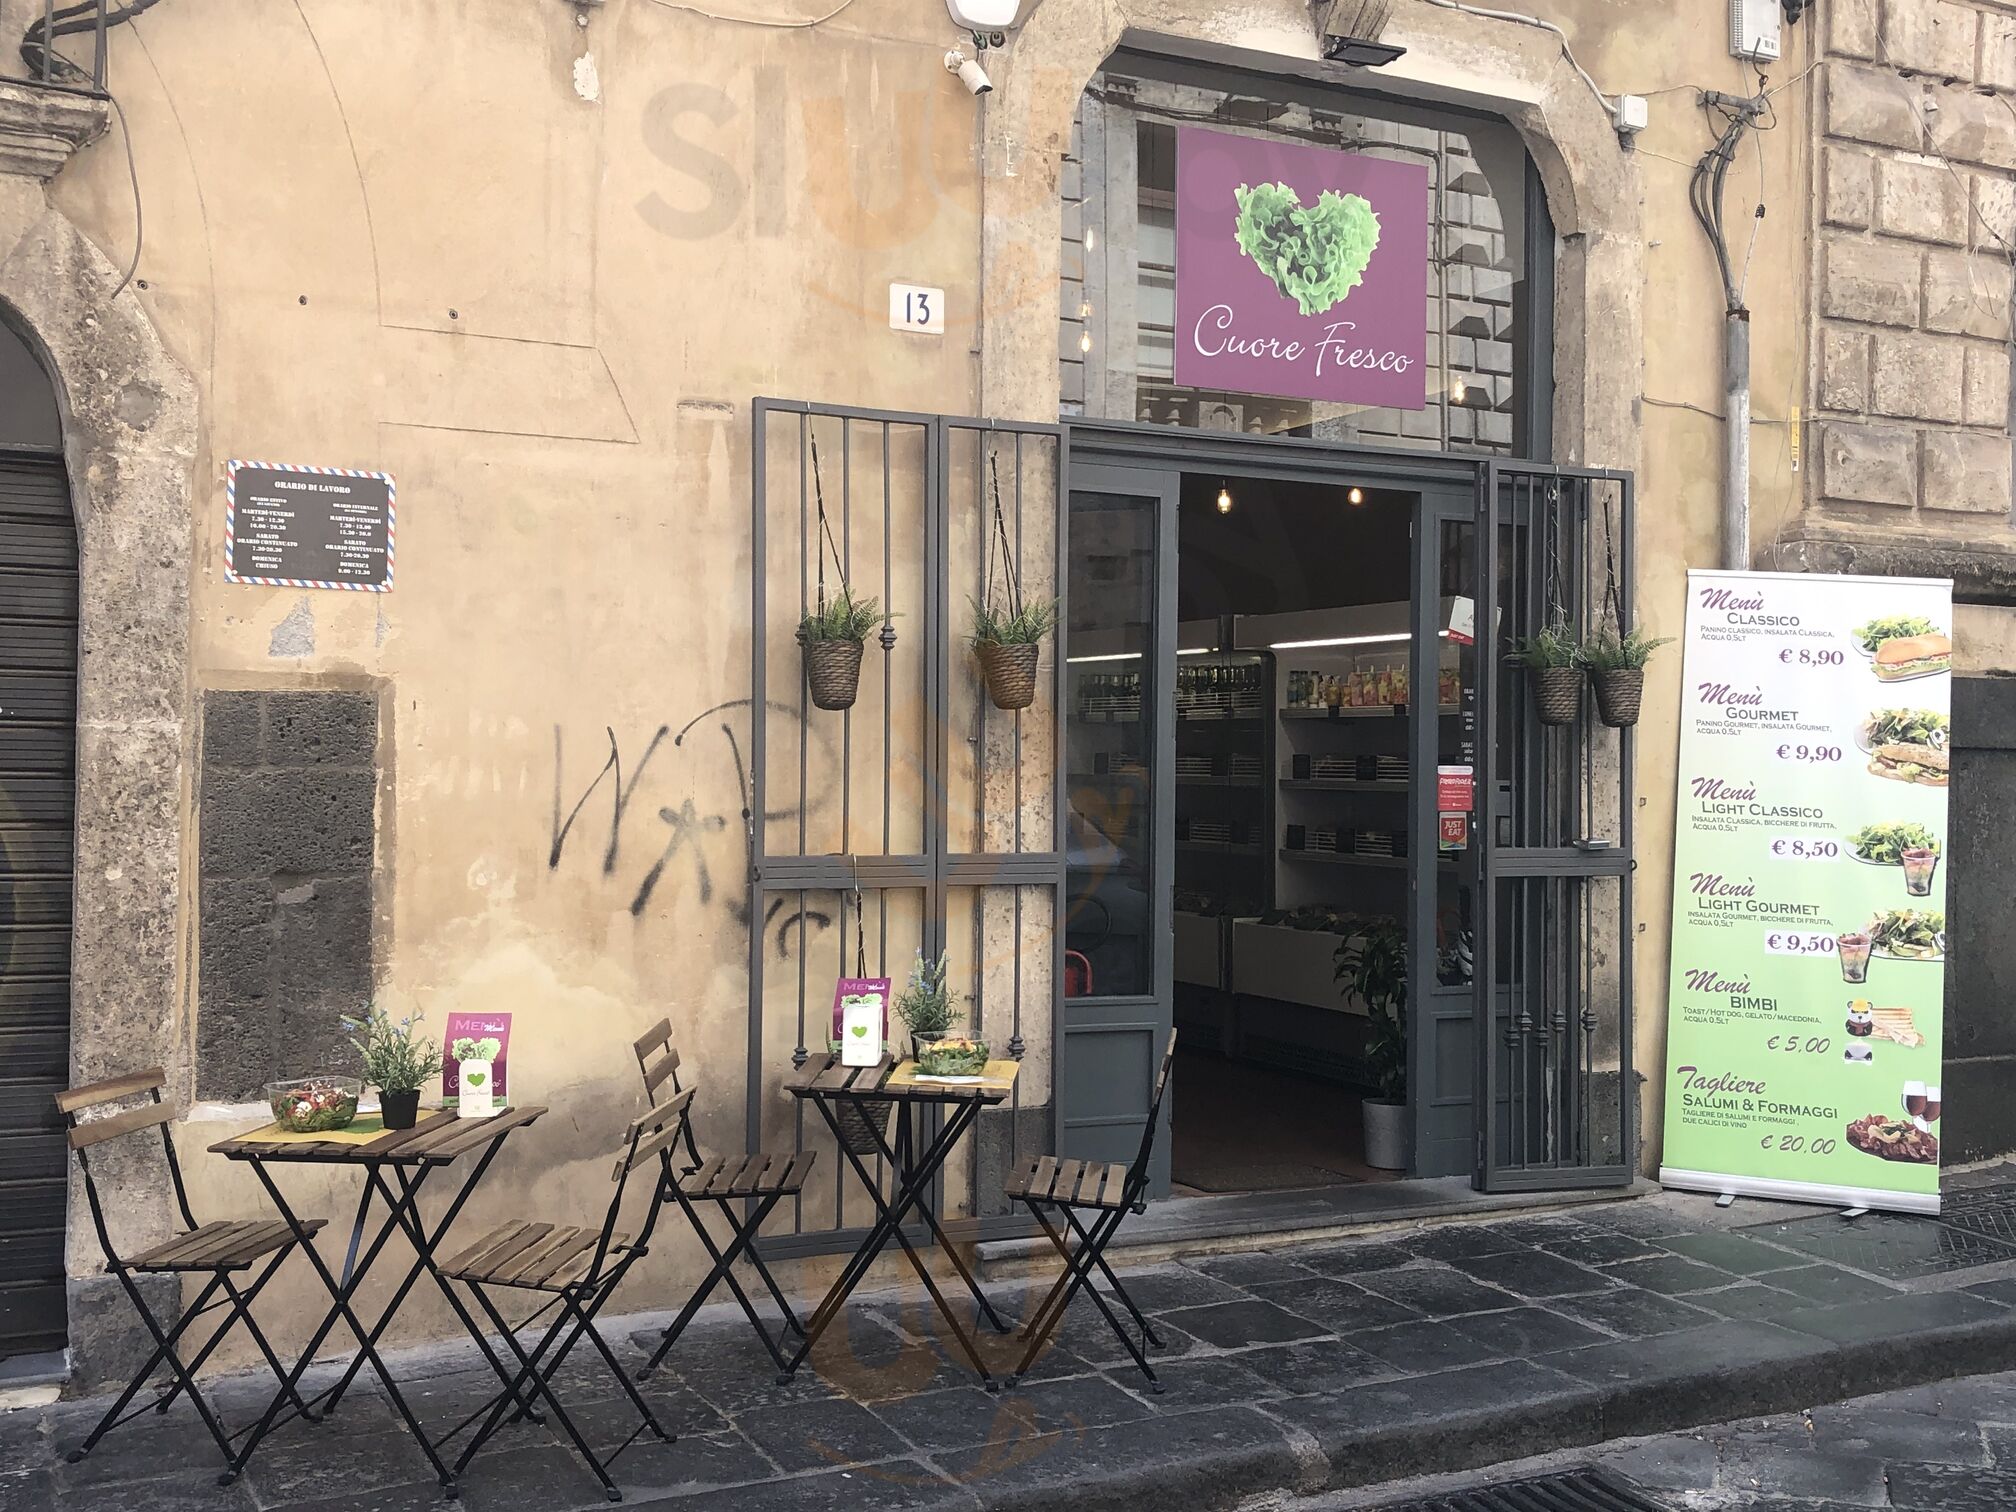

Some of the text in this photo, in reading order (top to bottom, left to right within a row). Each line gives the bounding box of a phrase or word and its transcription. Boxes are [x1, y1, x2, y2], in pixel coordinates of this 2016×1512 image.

[906, 292, 930, 325] 13
[1194, 304, 1415, 377] Cuore Fresco
[275, 481, 307, 490] ORARIO
[319, 485, 351, 493] LAVORO
[1700, 588, 1764, 611] Menù
[1778, 648, 1844, 667] € 8,90
[1698, 682, 1763, 706] Menù
[1776, 744, 1842, 763] € 9,90
[1691, 777, 1757, 801] Menù
[1444, 820, 1462, 829] JUST
[1771, 839, 1838, 859] € 8,50
[1690, 873, 1756, 897] Menù
[1767, 934, 1834, 954] € 9,50
[1685, 969, 1751, 994] Menù
[1730, 996, 1778, 1011] BIMBI
[1767, 1035, 1780, 1050] €
[1677, 1065, 1767, 1098] Tagliere
[1742, 1099, 1754, 1111] &
[1682, 1117, 1697, 1125] DUE
[1698, 1118, 1721, 1126] CALICI
[1729, 1121, 1747, 1129] VINO
[1716, 1111, 1724, 1119] DI
[1725, 1113, 1751, 1121] SALUMI
[1752, 1114, 1757, 1122] E
[1760, 1134, 1774, 1149] €
